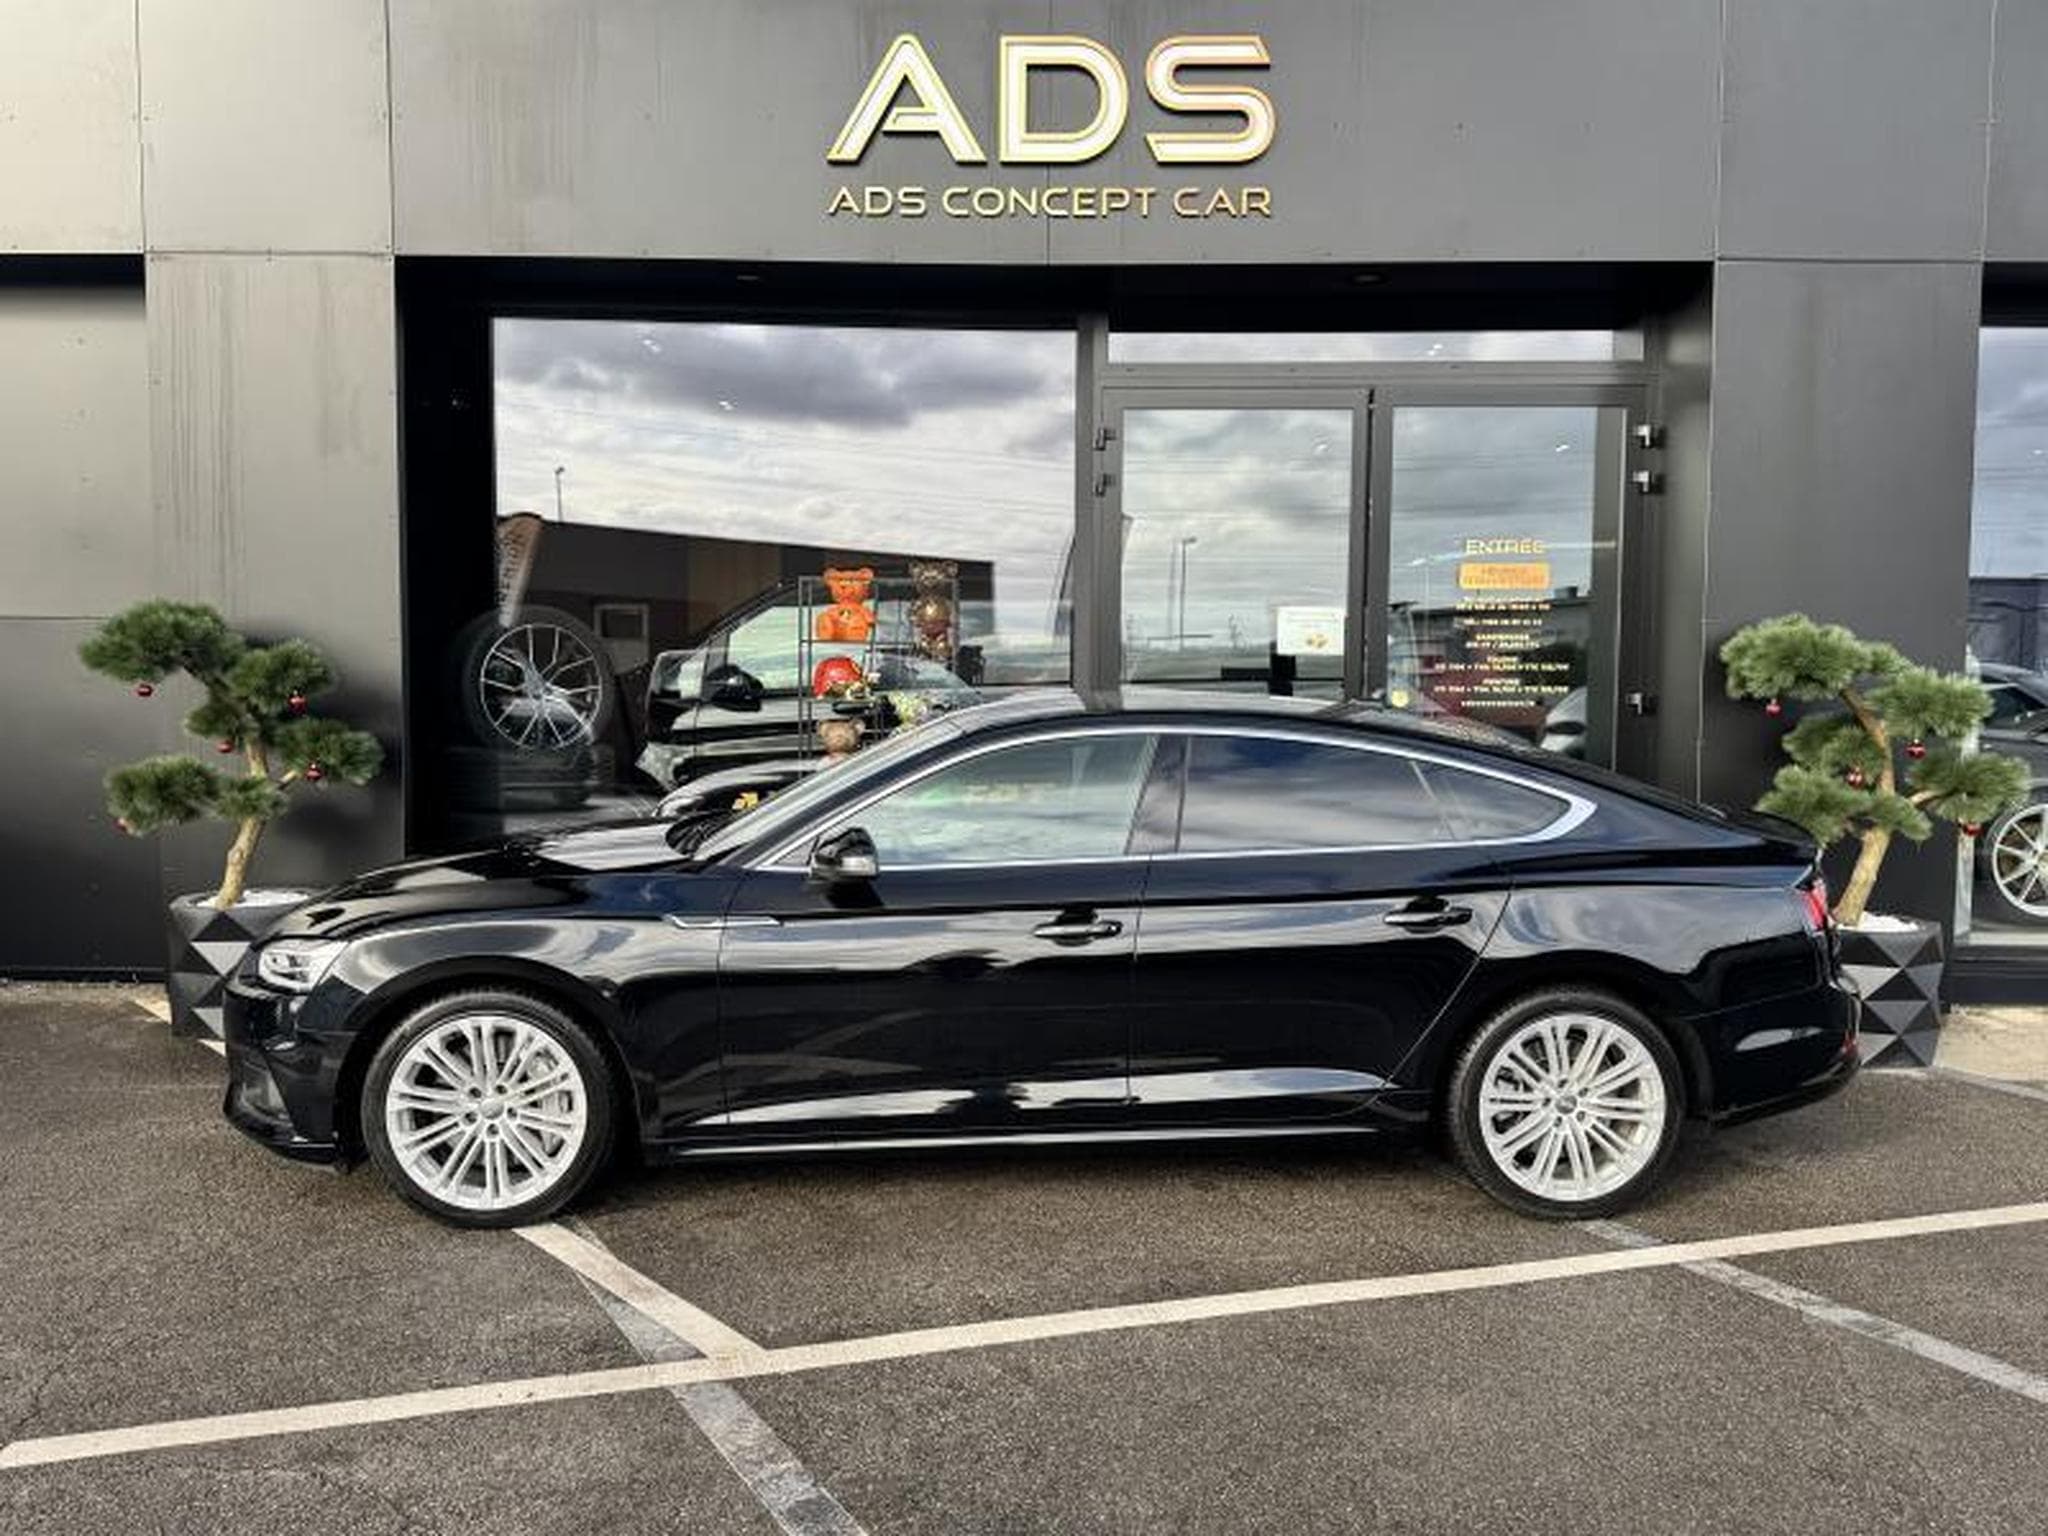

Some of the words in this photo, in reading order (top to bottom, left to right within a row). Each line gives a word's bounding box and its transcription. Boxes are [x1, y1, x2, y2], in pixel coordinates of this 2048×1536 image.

[827, 32, 1277, 164] ADS
[828, 186, 927, 217] ADS
[942, 187, 1156, 217] CONCEPT
[1174, 188, 1272, 217] CAR
